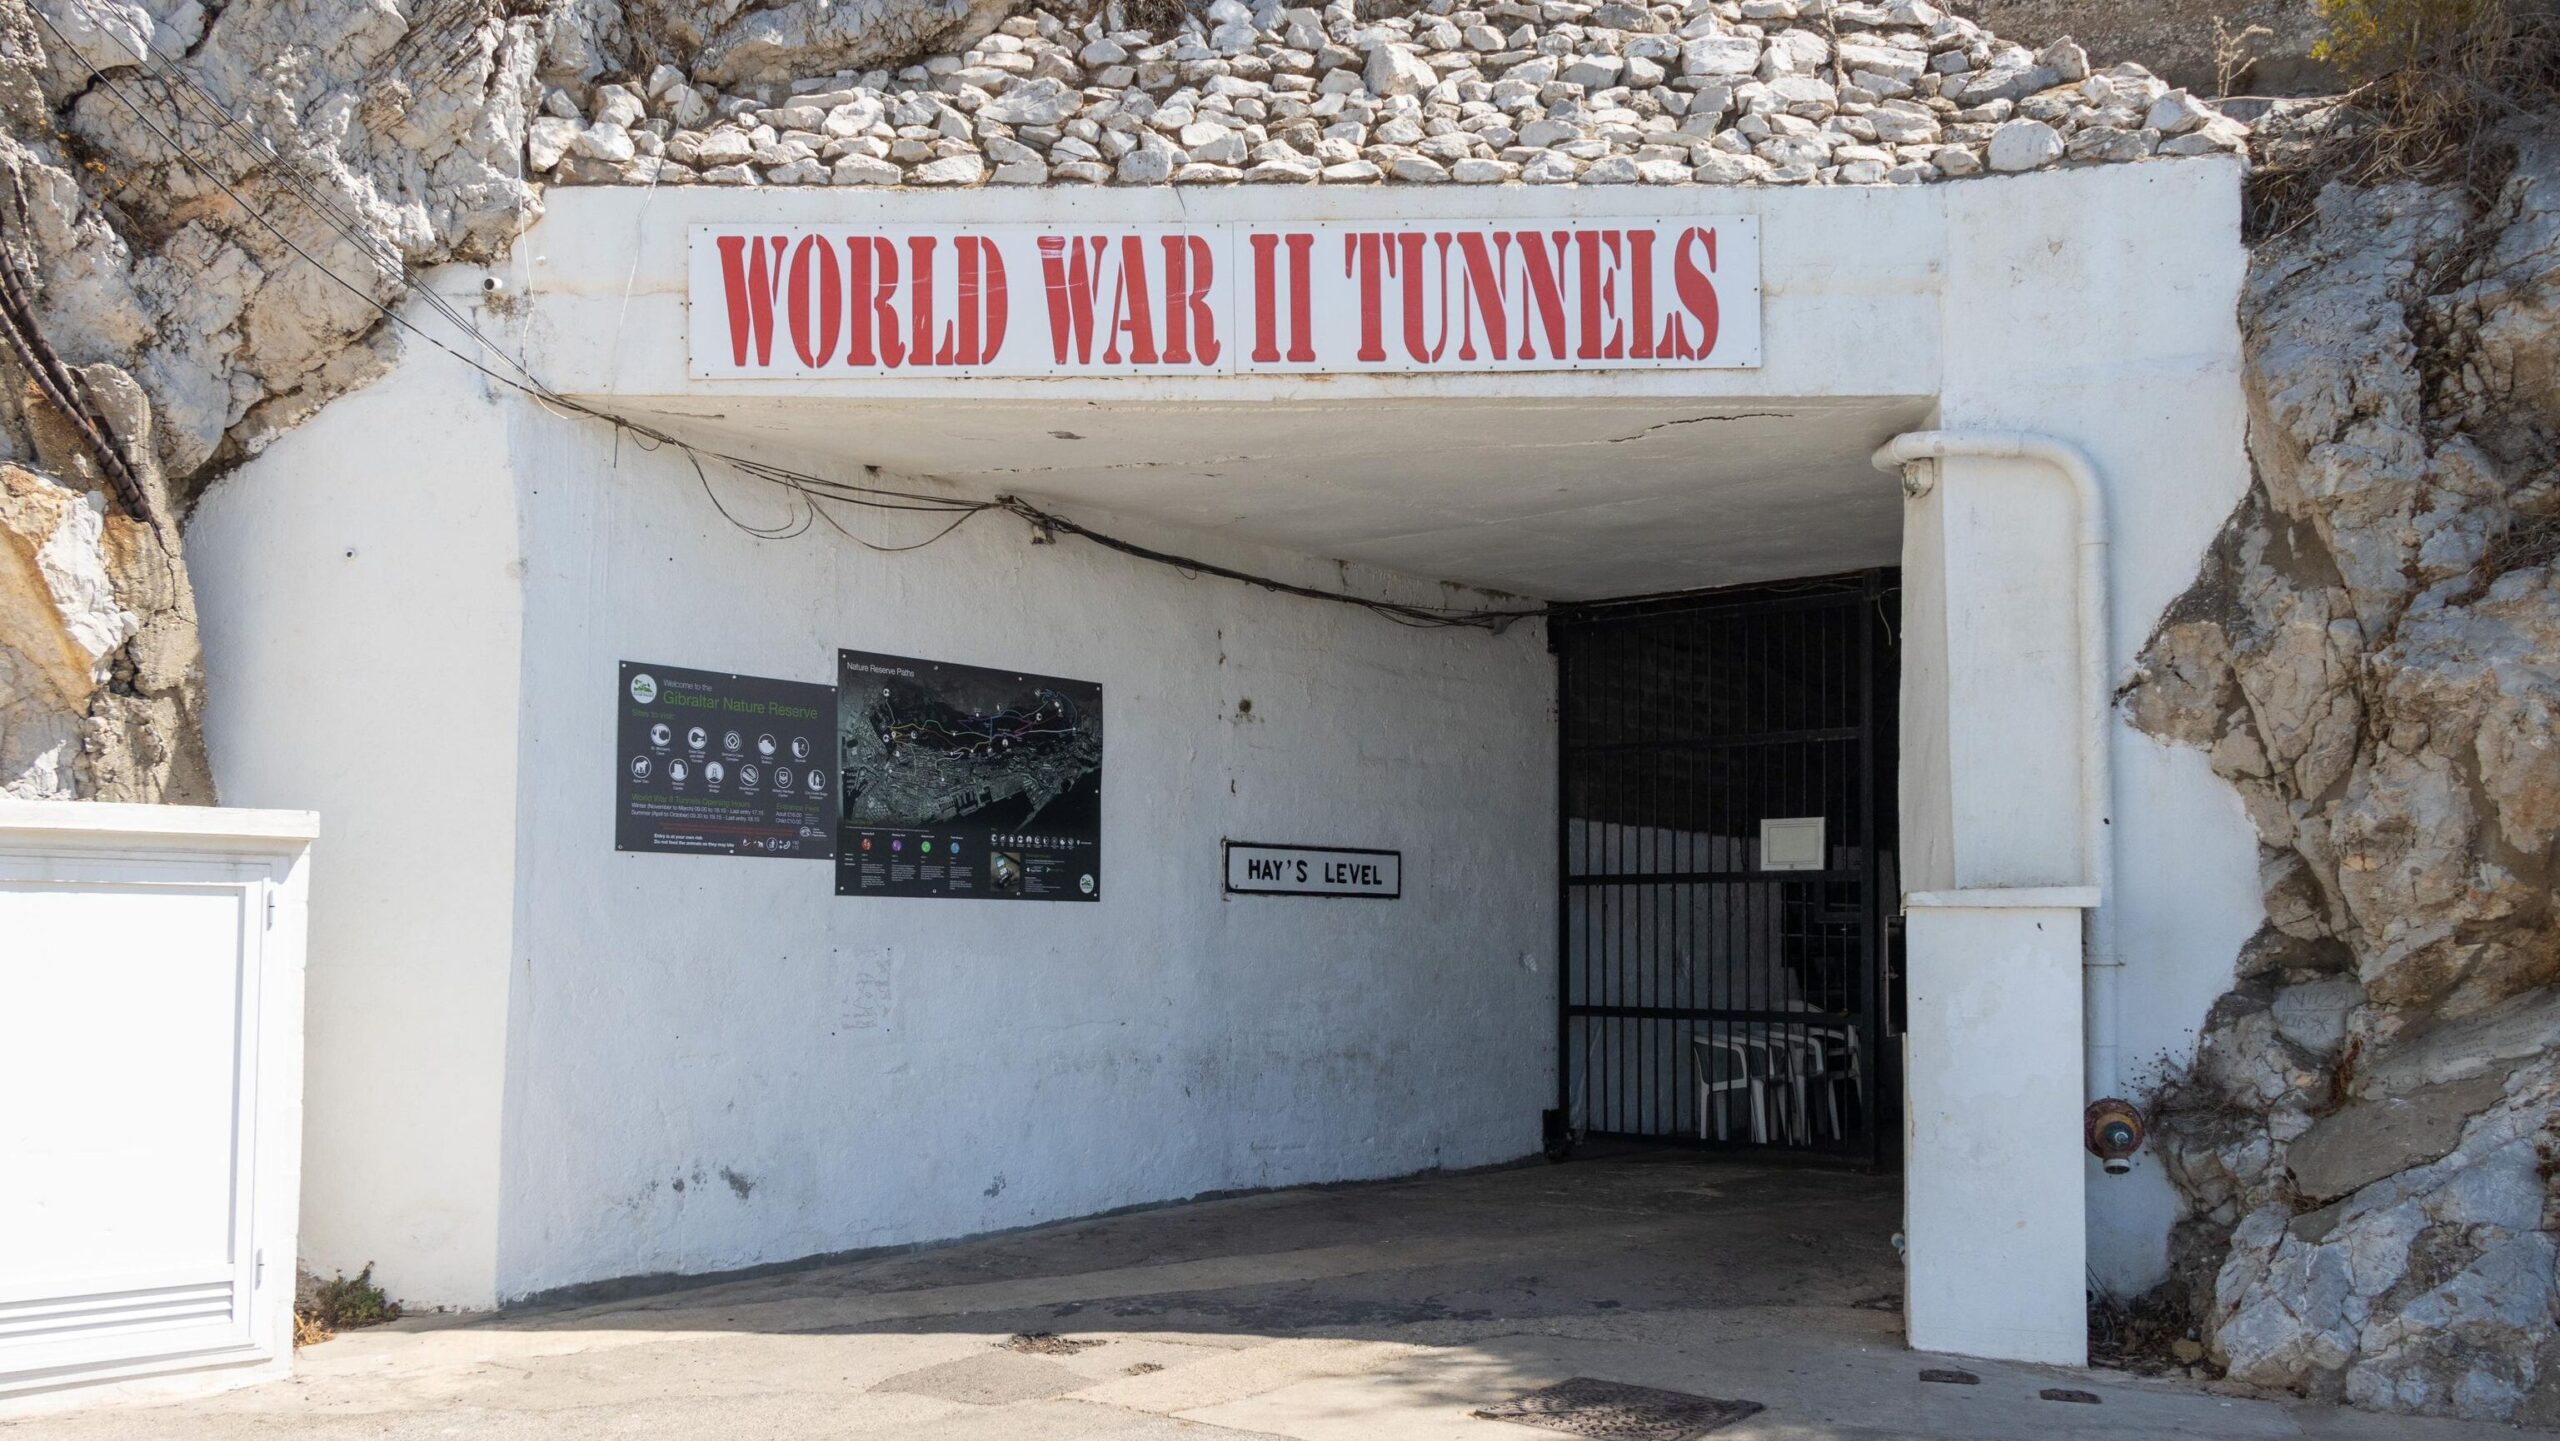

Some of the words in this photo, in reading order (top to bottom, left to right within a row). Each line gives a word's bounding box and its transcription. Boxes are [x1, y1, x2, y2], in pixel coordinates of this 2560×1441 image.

[718, 236, 1007, 367] WORLD
[1038, 236, 1219, 364] WAR
[1252, 235, 1314, 361] II
[1346, 227, 1718, 362] TUNNELS
[847, 662, 869, 672] Nature
[870, 665, 896, 675] Reserve
[897, 668, 915, 678] Paths
[663, 680, 693, 690] Welcome
[702, 683, 713, 692] the
[663, 690, 720, 709] Gibraltar
[723, 696, 765, 714] Nature
[768, 701, 818, 719] Reserve
[1248, 859, 1308, 883] HAY'S
[1325, 862, 1383, 886] LEVEL
